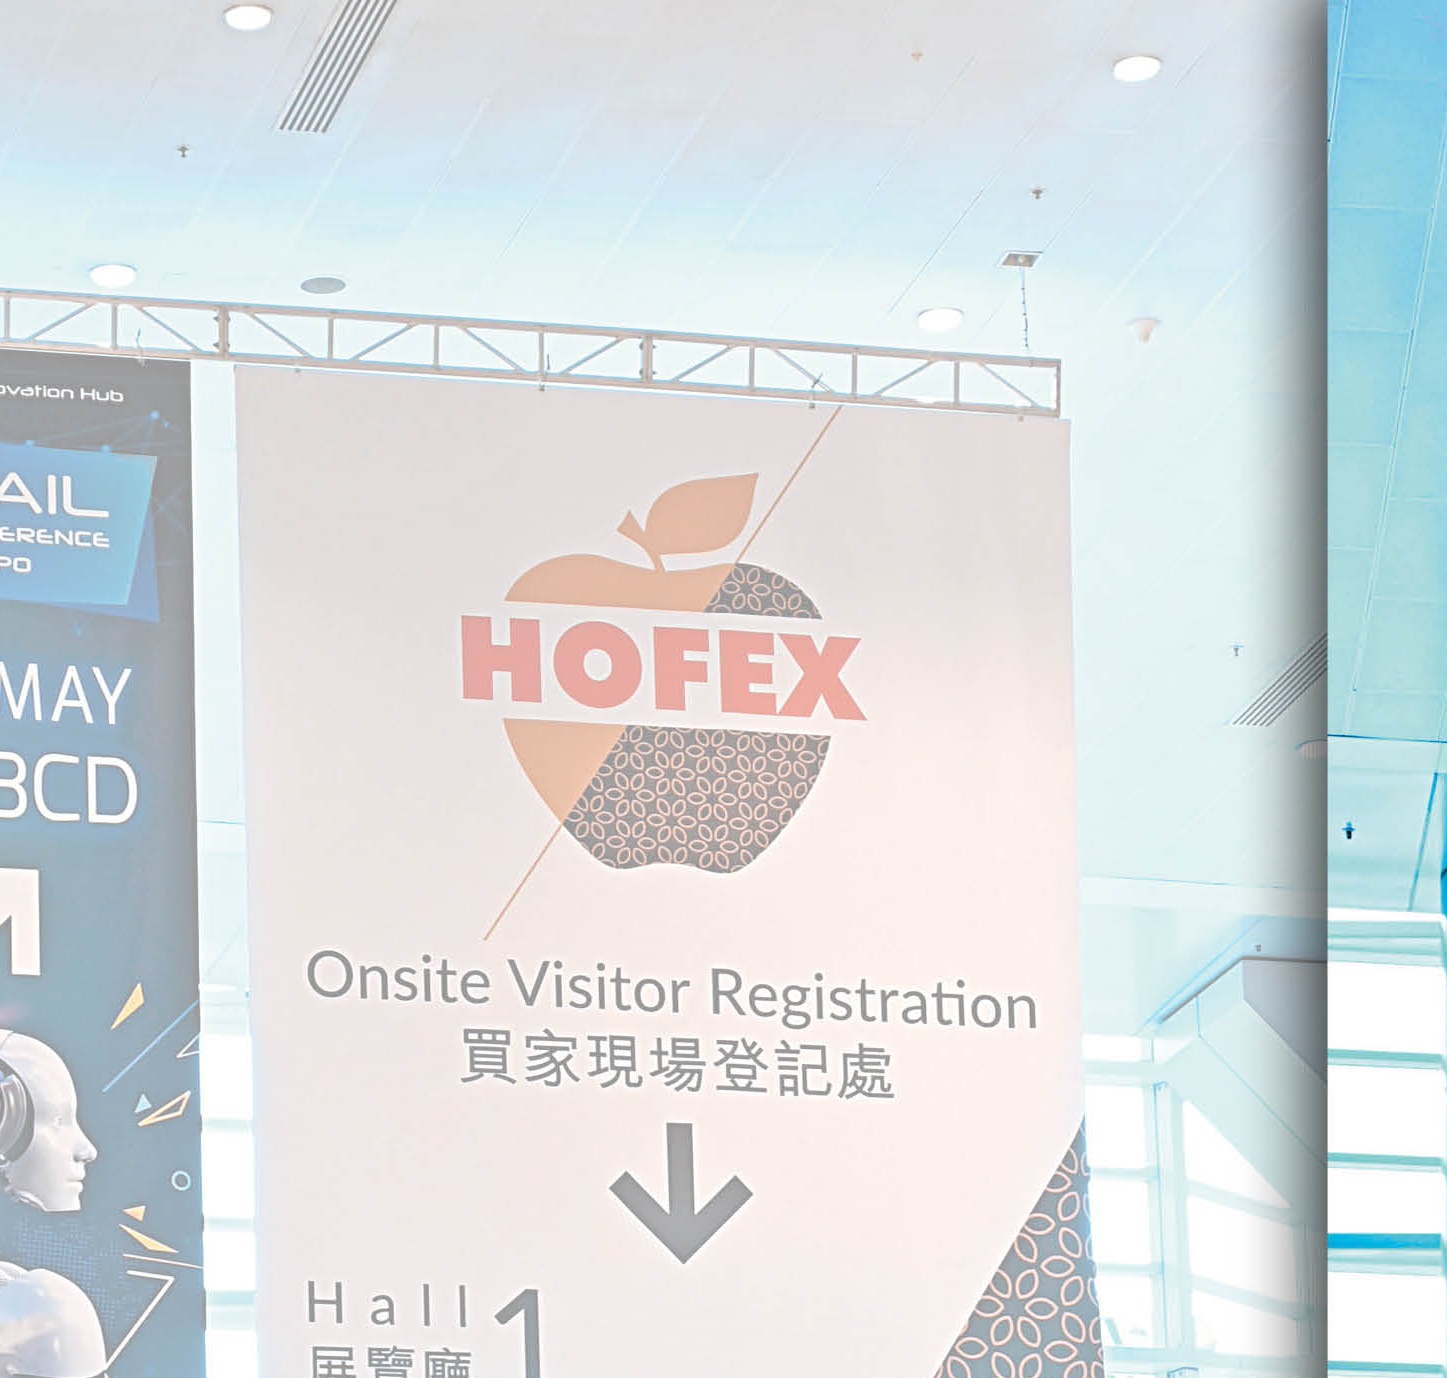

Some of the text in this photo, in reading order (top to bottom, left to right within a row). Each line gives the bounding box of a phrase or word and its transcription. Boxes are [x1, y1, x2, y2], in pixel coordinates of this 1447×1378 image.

[80, 387, 124, 402] Hub
[0, 661, 132, 725] MAY
[461, 615, 867, 721] HOFEX
[307, 950, 1038, 1030] Onsite Visitor Registration
[460, 1027, 895, 1100] 買家現場登記處
[307, 1280, 468, 1328] Hall
